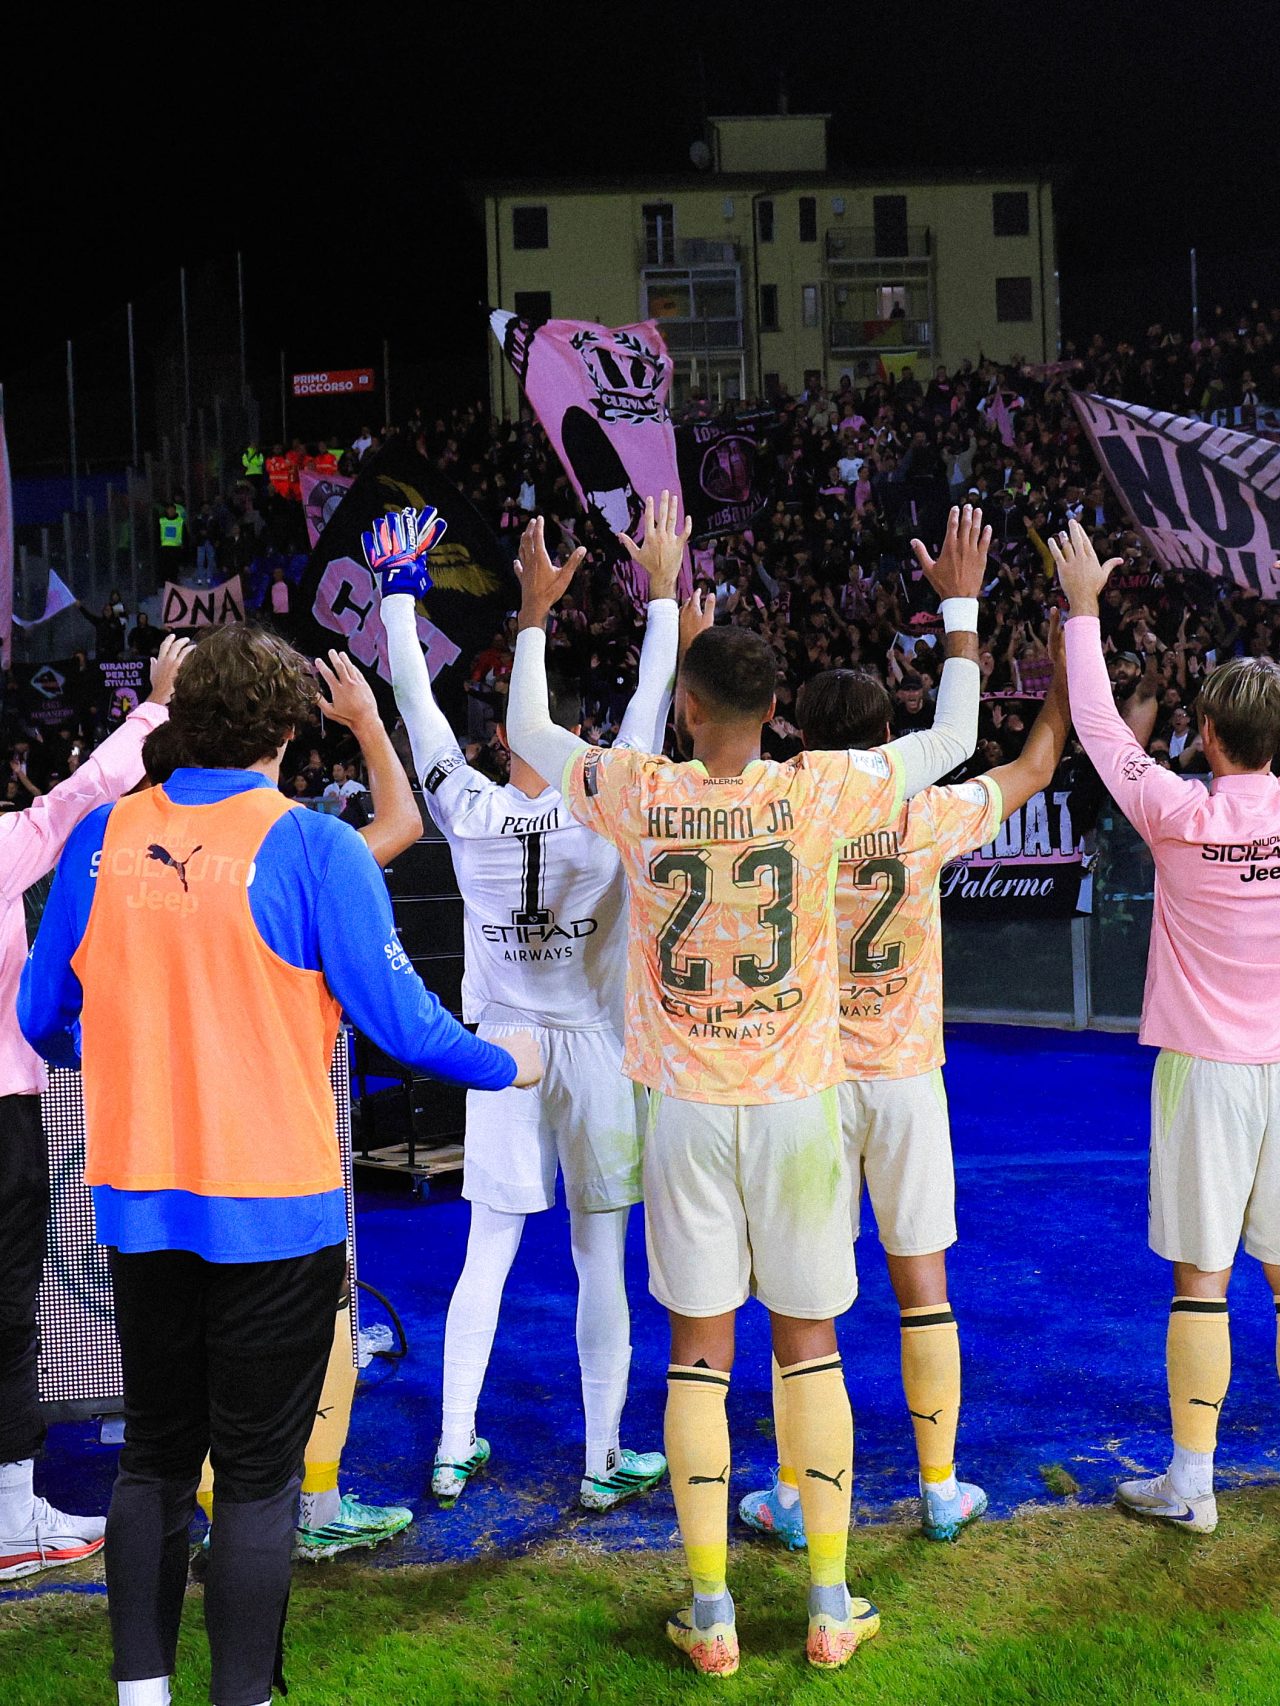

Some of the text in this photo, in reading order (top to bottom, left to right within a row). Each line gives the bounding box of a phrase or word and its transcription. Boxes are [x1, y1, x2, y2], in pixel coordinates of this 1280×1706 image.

[293, 373, 328, 385] PRIMO
[294, 381, 353, 394] SOCCORSO
[164, 587, 243, 624] DNA
[100, 661, 144, 672] GIRANDO
[105, 670, 139, 680] PER LO
[104, 678, 142, 688] STIVALE
[702, 777, 744, 787] PALERMO
[648, 799, 795, 840] HERNANI JR
[511, 832, 555, 926] 1
[940, 862, 1055, 899] Palermo
[126, 880, 200, 917] Jeep
[650, 839, 798, 997] 23
[481, 918, 598, 944] ETIHAD
[504, 946, 573, 962] AIRWAYS
[661, 986, 803, 1024] ETIHAD
[688, 1023, 776, 1041] AIRWAYS
